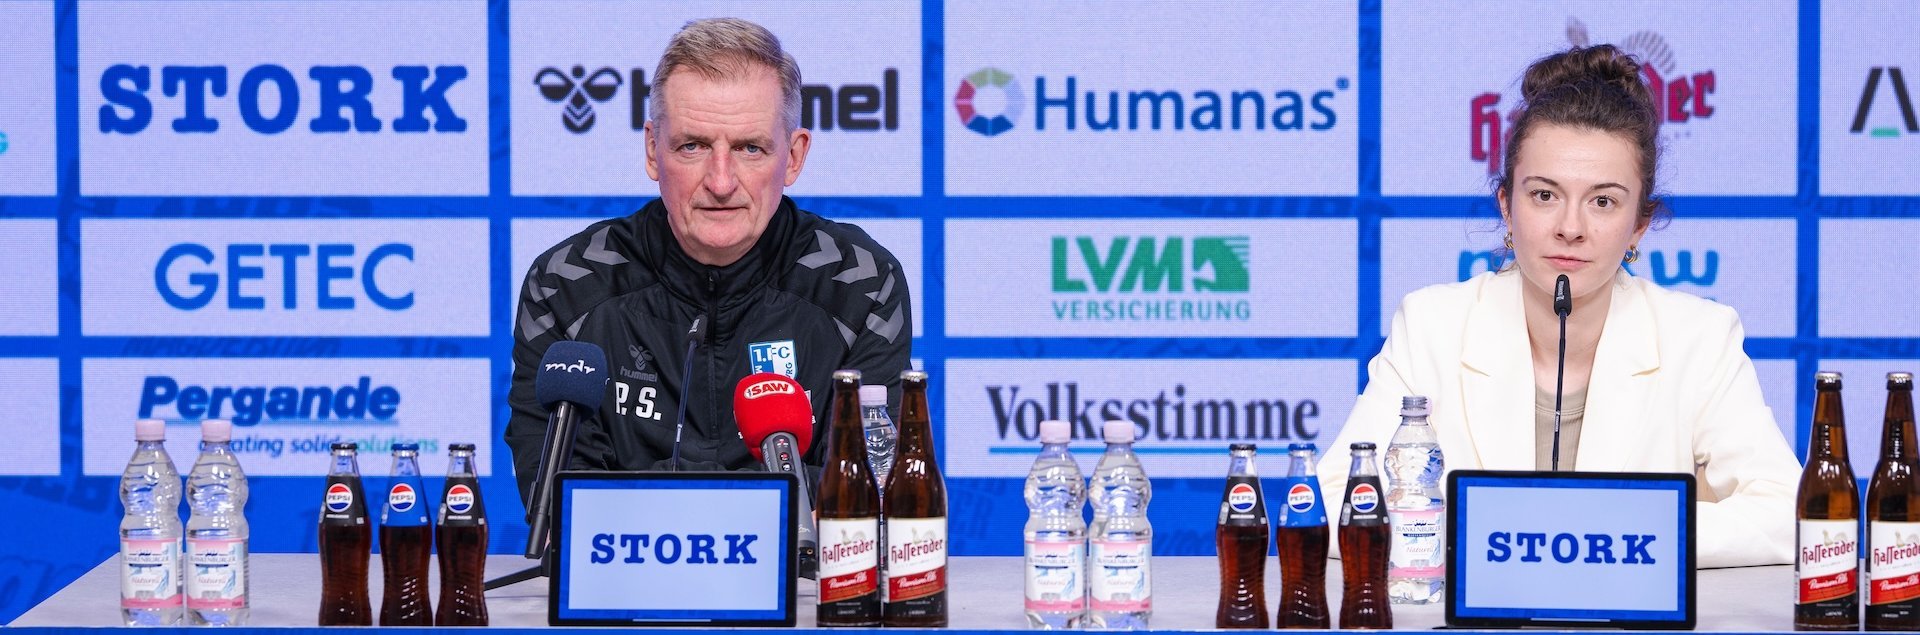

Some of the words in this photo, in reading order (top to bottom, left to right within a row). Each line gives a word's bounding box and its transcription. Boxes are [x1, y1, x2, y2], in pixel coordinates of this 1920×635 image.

[99, 64, 468, 134] STORK
[1035, 76, 1337, 131] Humanas
[154, 243, 415, 310] GETEC
[1051, 236, 1184, 292] LVM
[1053, 300, 1251, 320] VERSICHERUNG
[545, 359, 595, 374] mdr
[619, 366, 658, 382] hummel
[138, 377, 401, 426] Pergande
[635, 387, 662, 421] S.
[752, 383, 788, 397] SAW
[985, 382, 1320, 441] Volksstimme
[590, 534, 758, 565] STORK
[1487, 532, 1656, 565] STORK
